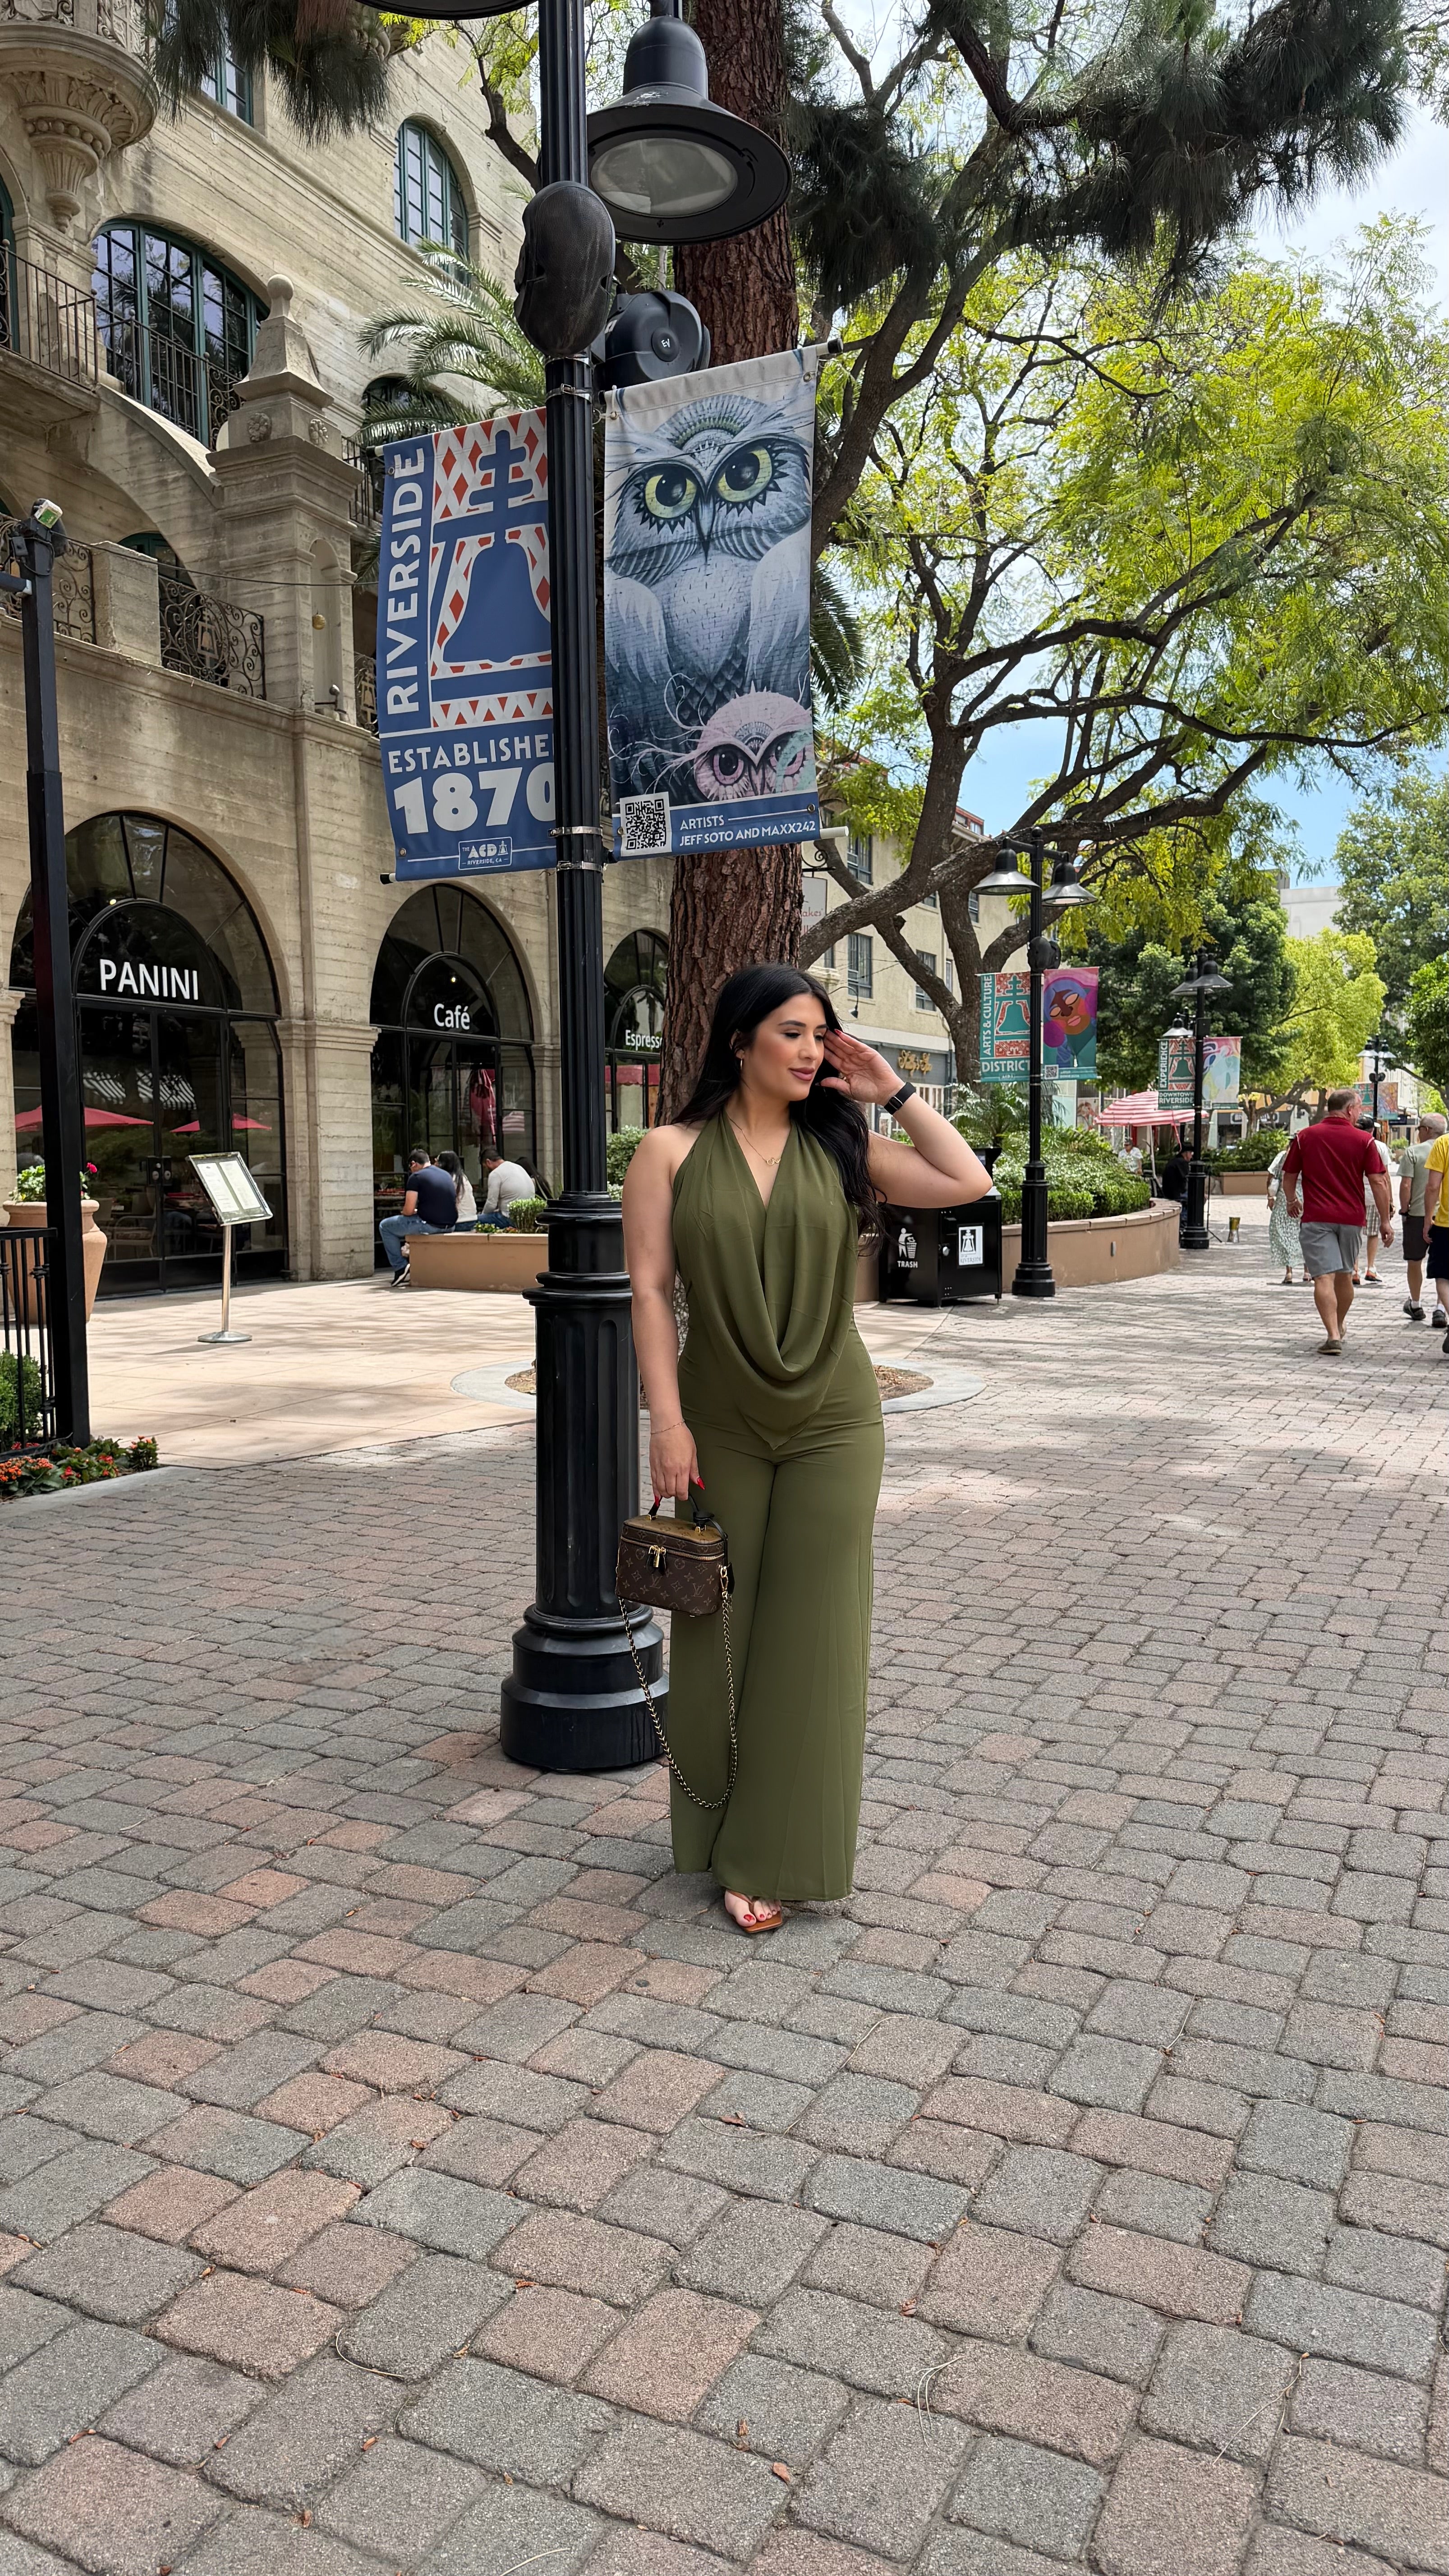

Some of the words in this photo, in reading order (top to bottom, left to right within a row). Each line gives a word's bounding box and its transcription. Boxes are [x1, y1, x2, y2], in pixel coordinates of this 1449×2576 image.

[661, 338, 670, 348] EV
[386, 448, 424, 714] RIVERSIDE
[388, 733, 554, 773] ESTABLISHE
[394, 762, 556, 834] 1870
[680, 815, 725, 831] ARTISTS
[680, 834, 701, 846] JEFF
[704, 831, 733, 843] SOTO
[736, 828, 759, 840] AND
[762, 821, 815, 837] MAXX242
[100, 959, 198, 1000] PANINI
[983, 975, 992, 1019] CULTURE
[434, 1003, 470, 1030] Café
[983, 1020, 991, 1028] &
[983, 1030, 991, 1056] ARTS
[982, 1060, 1030, 1072] DISTRICT
[1160, 1041, 1168, 1088] EXPERIENCE
